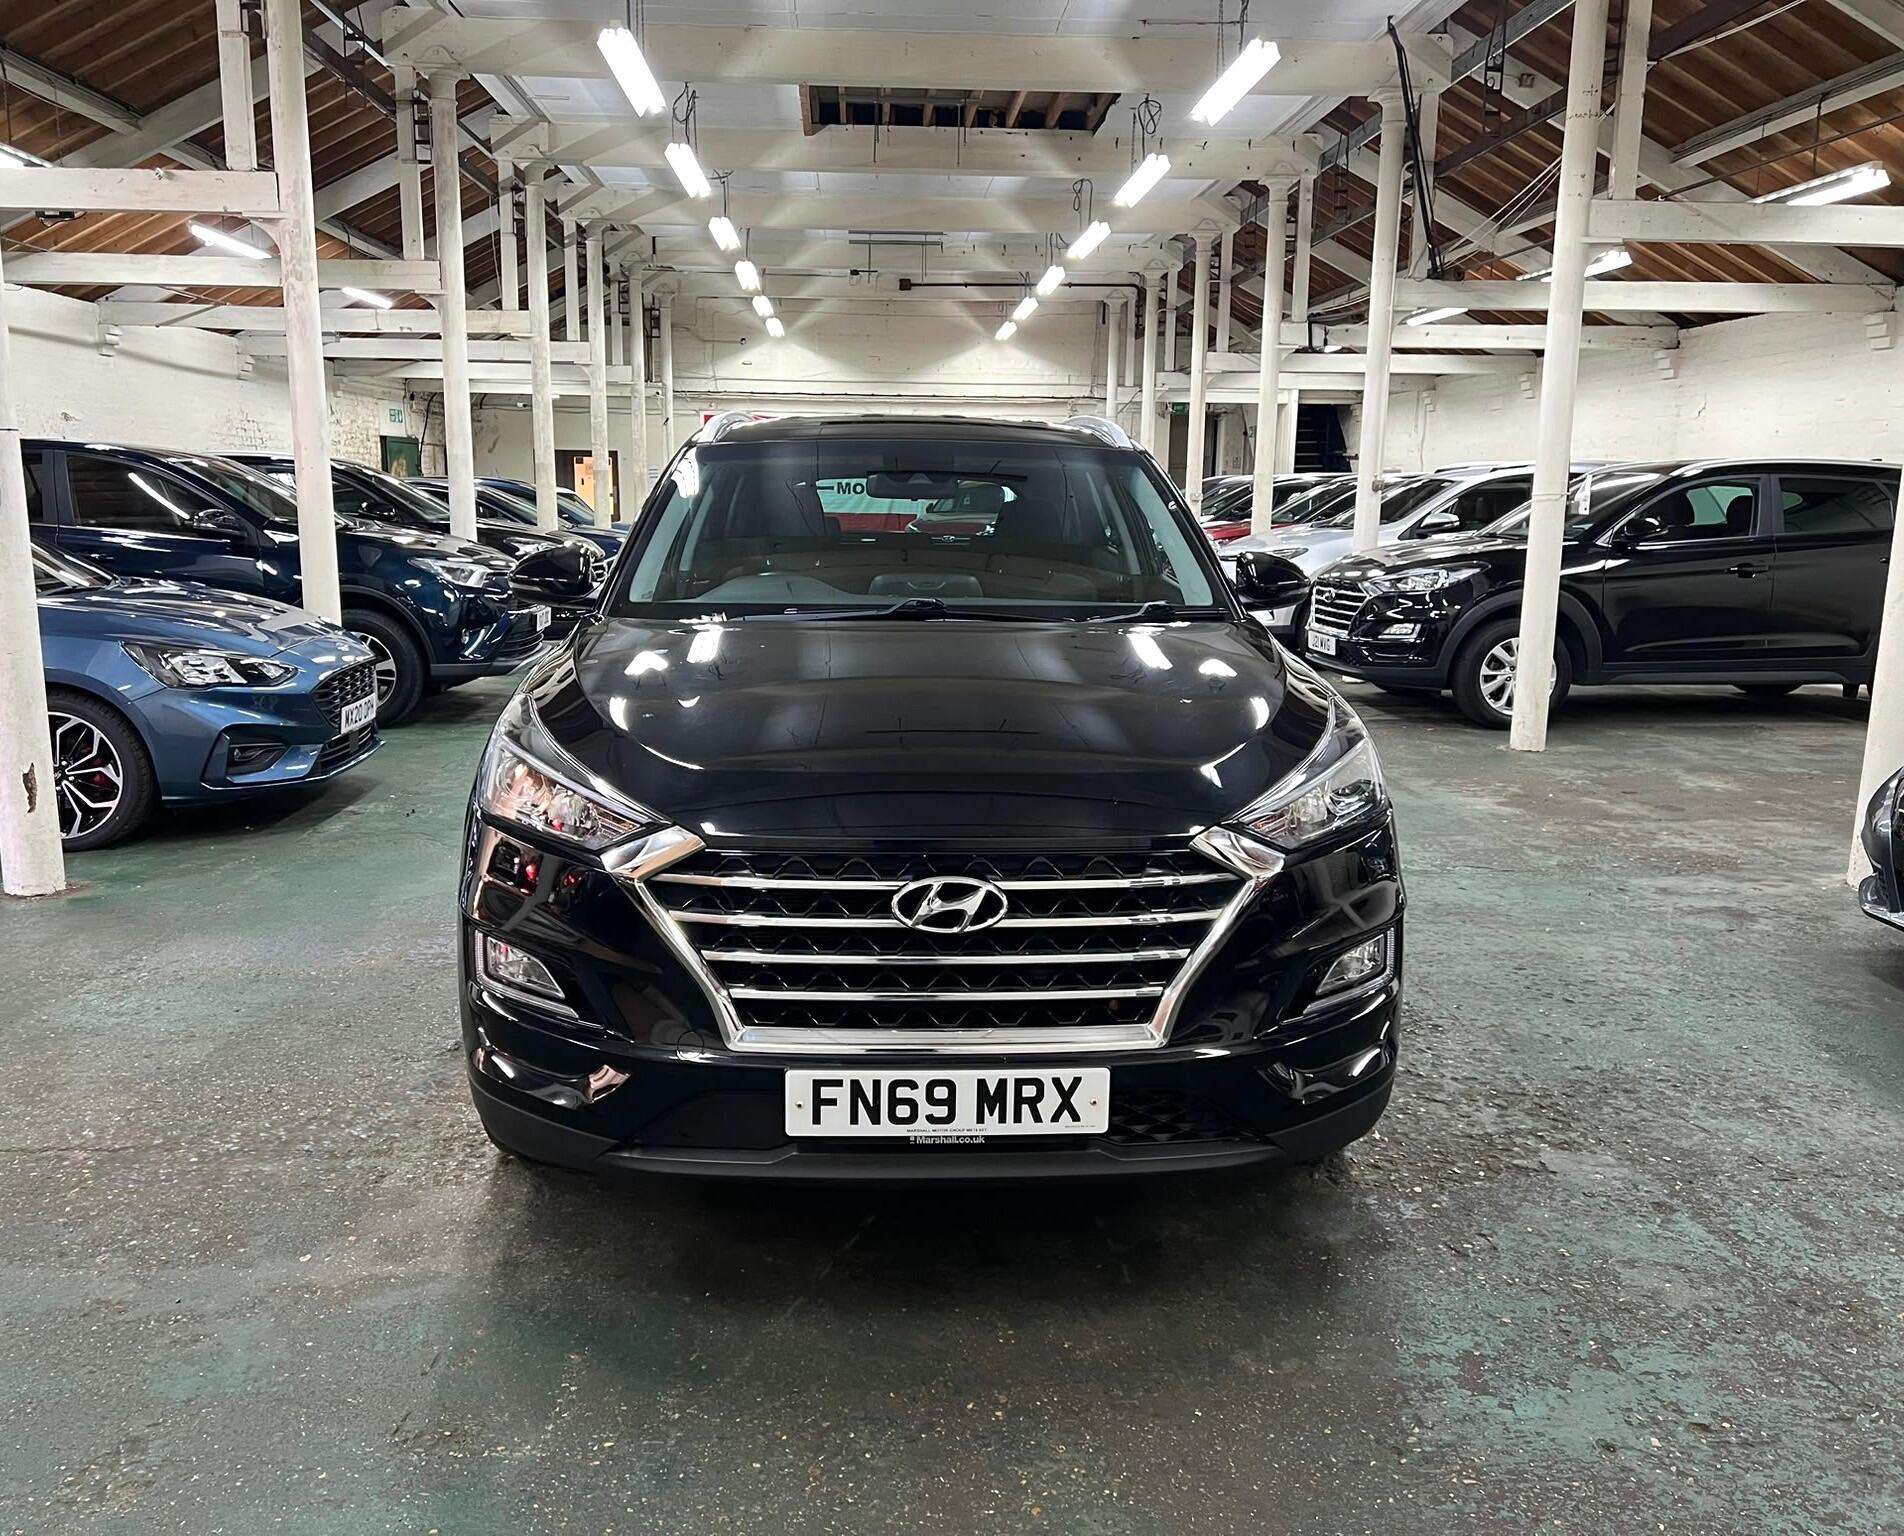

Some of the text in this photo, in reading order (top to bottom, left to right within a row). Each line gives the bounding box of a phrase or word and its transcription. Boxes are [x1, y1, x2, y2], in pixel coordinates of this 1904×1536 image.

[811, 1076, 1083, 1126] FN69 MRX
[916, 1135, 986, 1144] Marshall.co.uk
